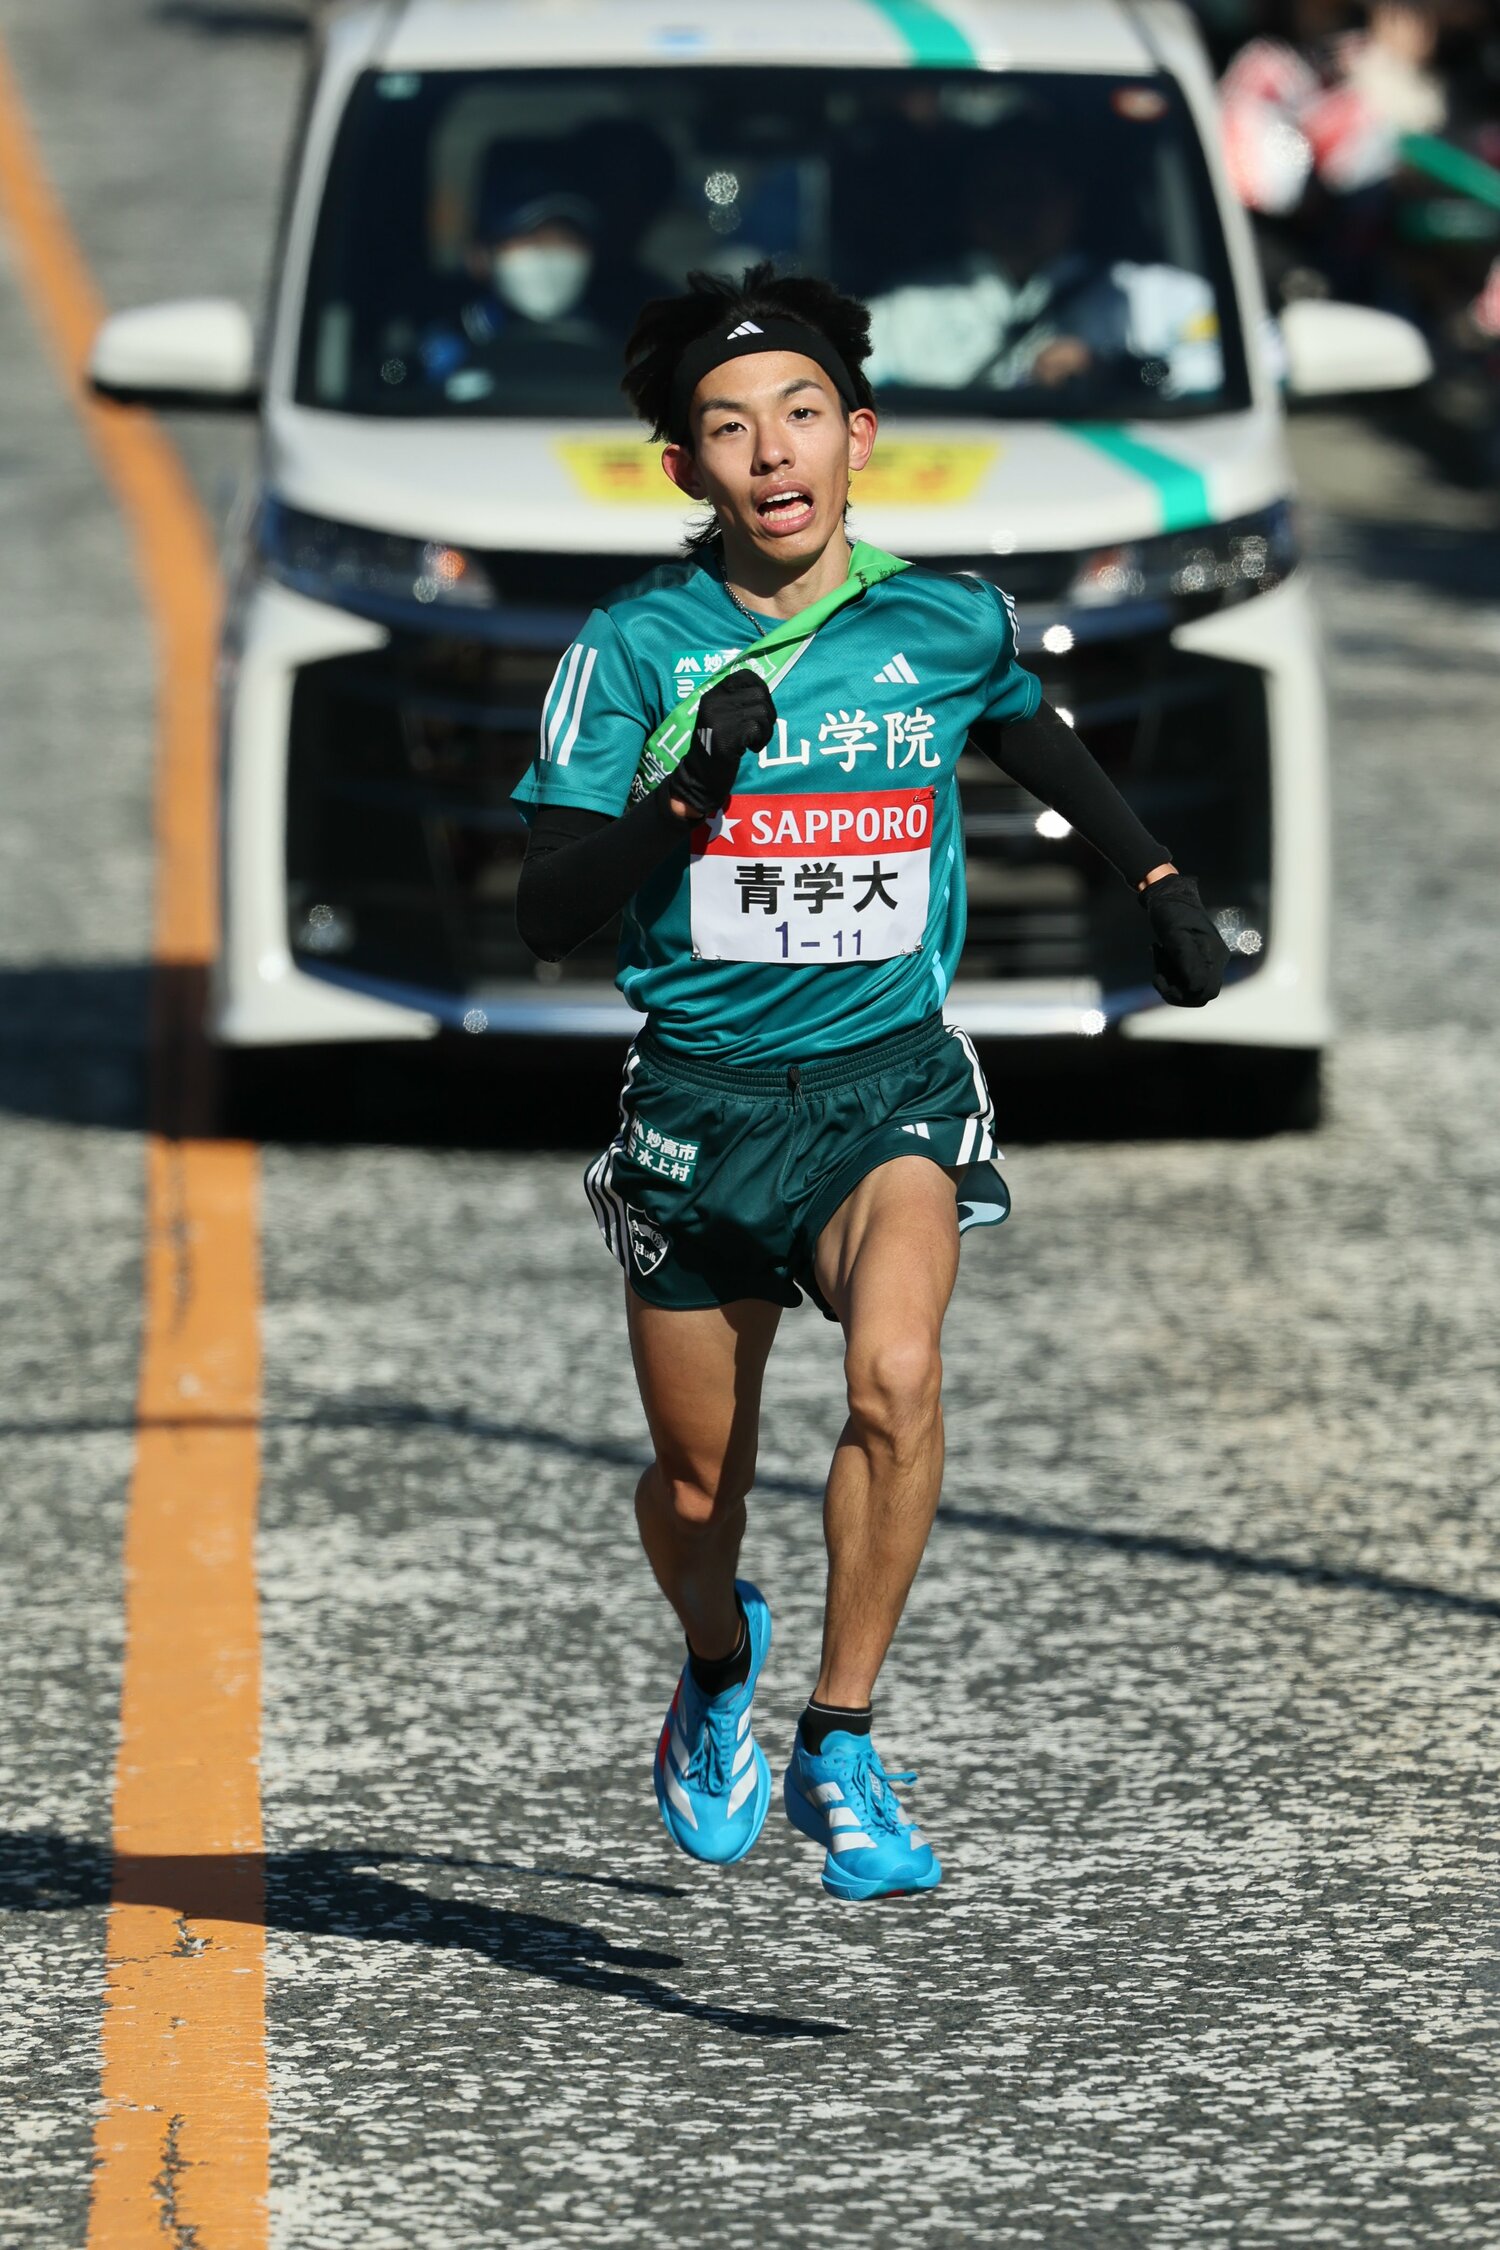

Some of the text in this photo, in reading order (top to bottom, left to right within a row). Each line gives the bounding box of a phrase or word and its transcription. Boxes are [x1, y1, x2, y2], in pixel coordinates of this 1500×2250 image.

[757, 706, 942, 773] 山学院
[750, 803, 928, 845] SAPPORO
[733, 860, 899, 915] 青学大
[637, 1149, 691, 1182] 水上村
[645, 1128, 698, 1161] 妙高市
